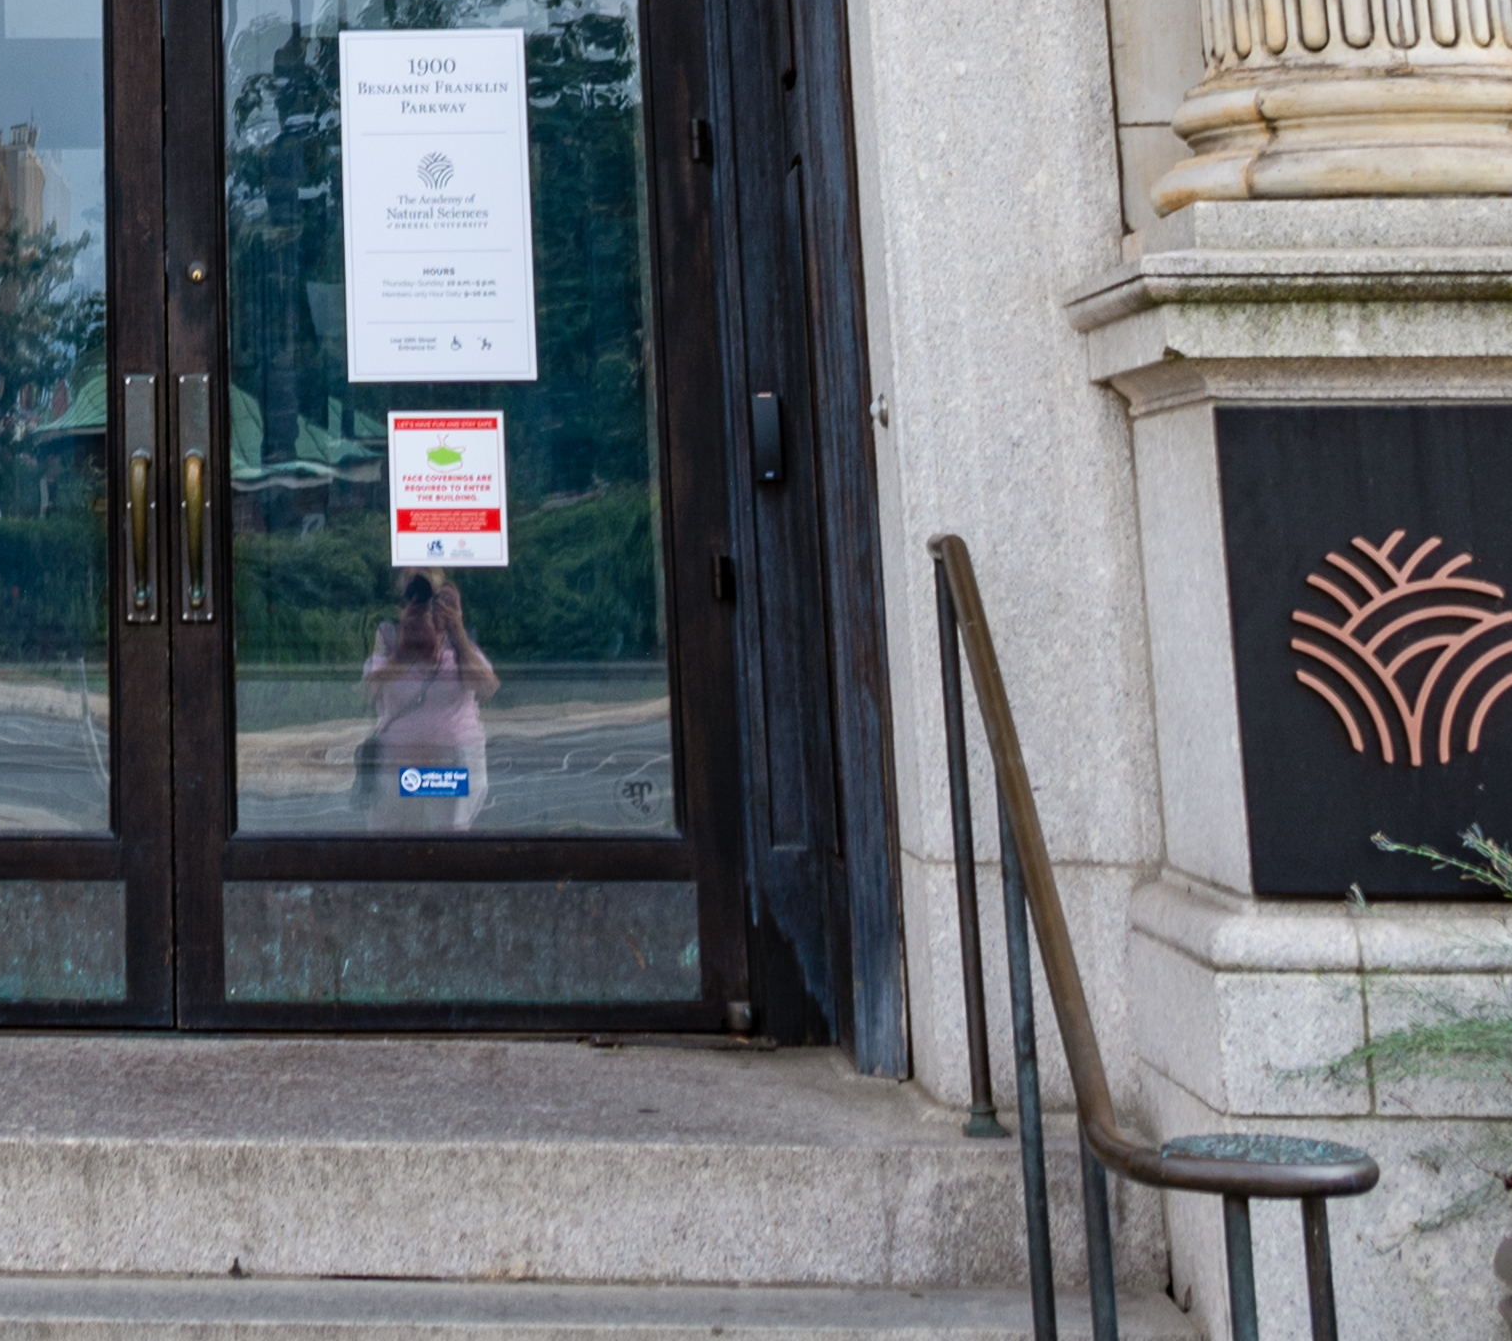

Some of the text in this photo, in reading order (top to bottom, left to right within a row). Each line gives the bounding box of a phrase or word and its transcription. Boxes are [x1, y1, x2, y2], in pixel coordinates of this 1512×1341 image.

[408, 58, 456, 77] 1900
[397, 194, 476, 206] The Academy of
[386, 207, 489, 220] Natural Sciences
[423, 268, 455, 276] HOURS
